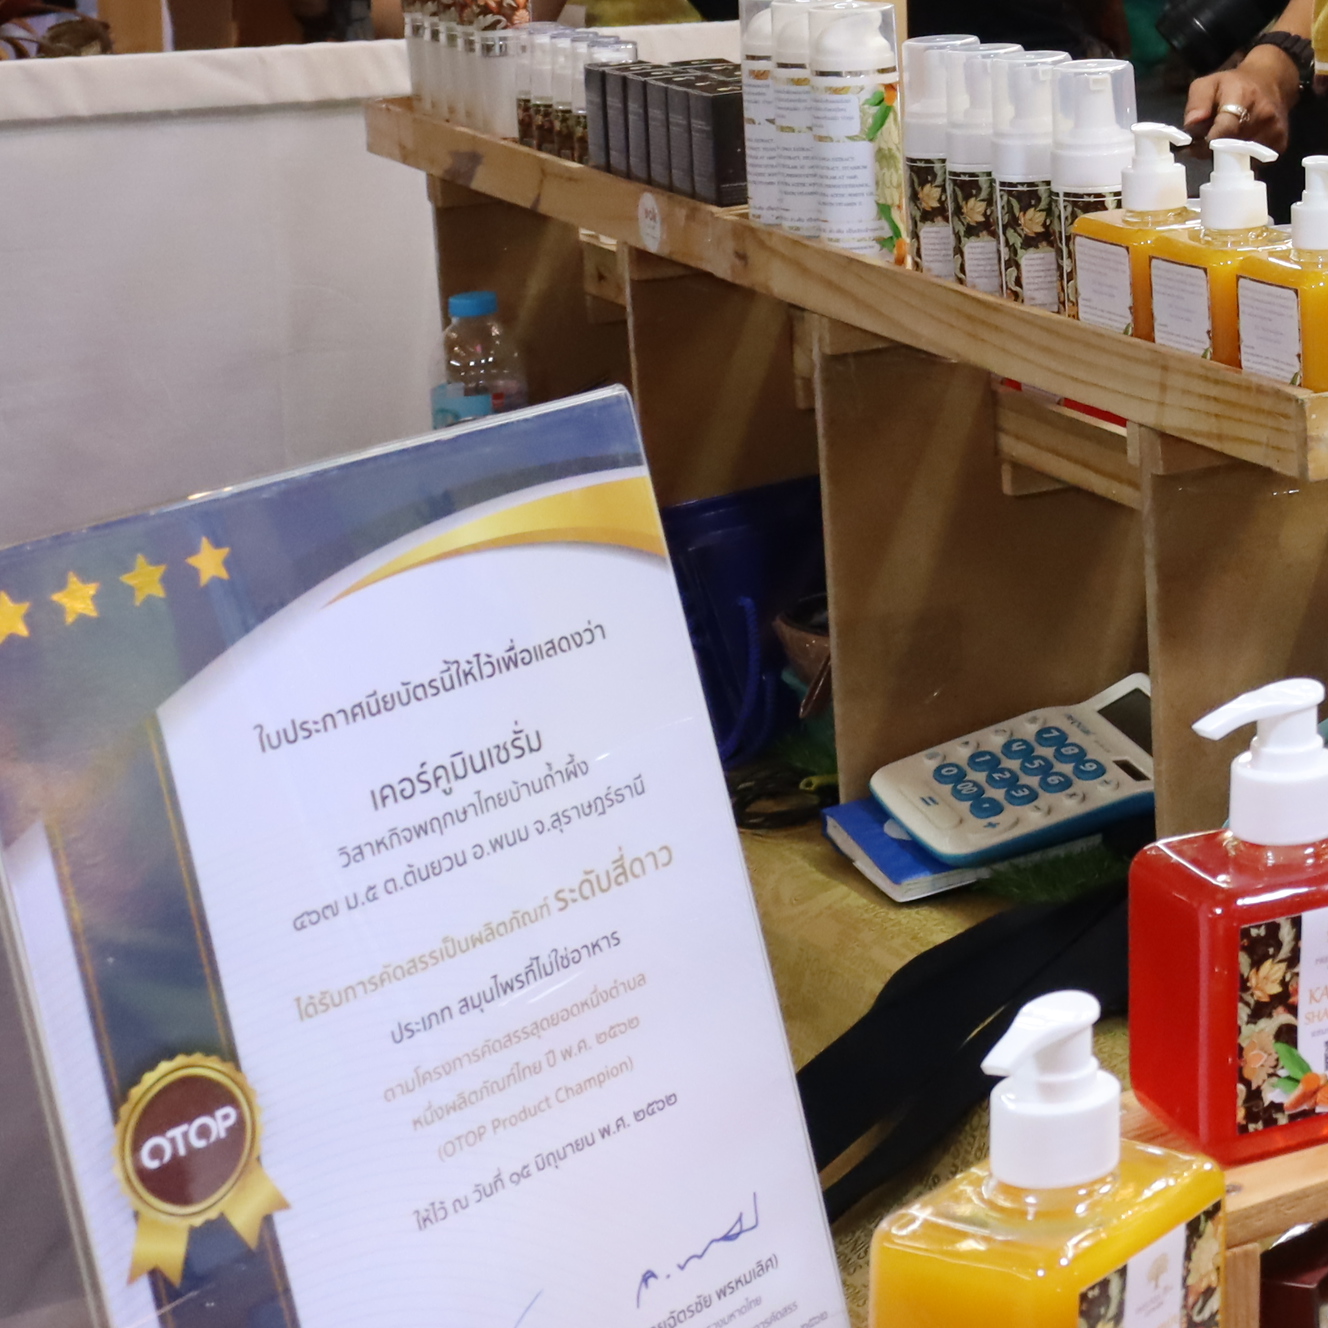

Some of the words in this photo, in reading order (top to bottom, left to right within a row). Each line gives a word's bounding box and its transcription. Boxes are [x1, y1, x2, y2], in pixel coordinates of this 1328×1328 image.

[253, 621, 608, 754] ใบประกาศนียบัตรนี้ให้ไว้เพื่อแสดงว่า
[370, 720, 543, 812] เคอร์คูมินเซรั่ม
[976, 754, 992, 762] 1
[992, 767, 1012, 780] 2
[1010, 787, 1029, 798] 3
[1025, 759, 1045, 770] 5
[1046, 774, 1065, 785] 6
[1042, 729, 1060, 738] 7
[1060, 745, 1079, 755] 8
[1079, 762, 1097, 772] 9
[338, 753, 590, 869] วิสาหกิจพฤกษาไทยบ้านถ้ำผึ้ง
[472, 826, 530, 861] อ.พนม
[533, 774, 648, 836] จ.สุราษฎร์ธานี
[555, 843, 674, 913] ระดับสี่ดาว
[391, 1005, 453, 1045] ประเภท
[491, 1095, 553, 1136] Product
[554, 1055, 636, 1104] Champion)
[140, 1105, 238, 1170] OTOP
